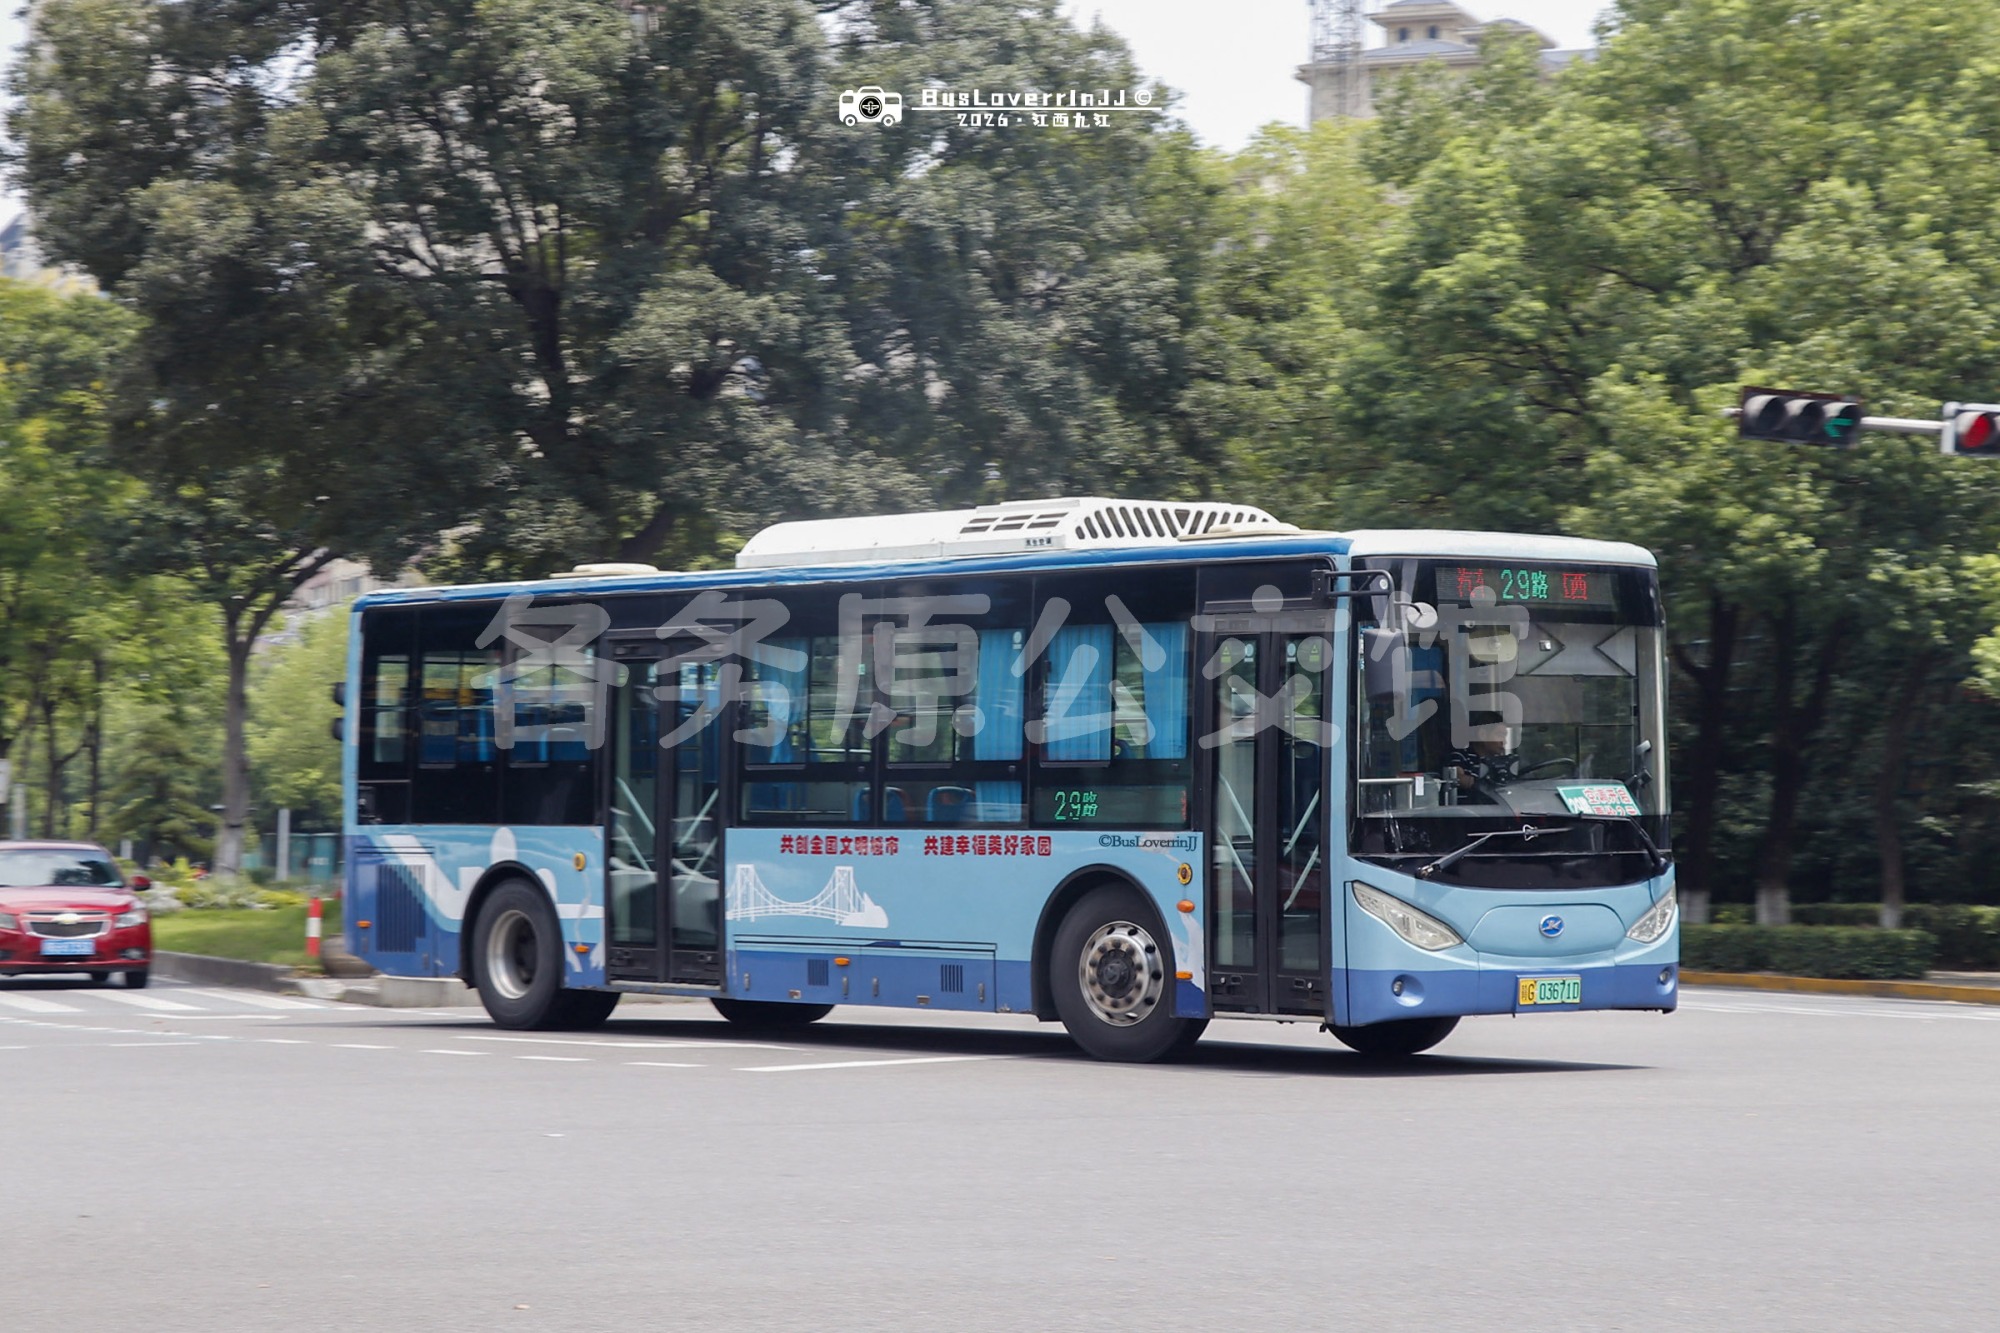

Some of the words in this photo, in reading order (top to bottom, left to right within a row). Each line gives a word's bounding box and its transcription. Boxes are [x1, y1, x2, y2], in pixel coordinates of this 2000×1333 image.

[1500, 569, 1549, 600] 29路
[1054, 791, 1099, 820] 29路
[780, 835, 899, 856] 共创全国文明城市
[924, 835, 1052, 856] 共建幸福美好家园
